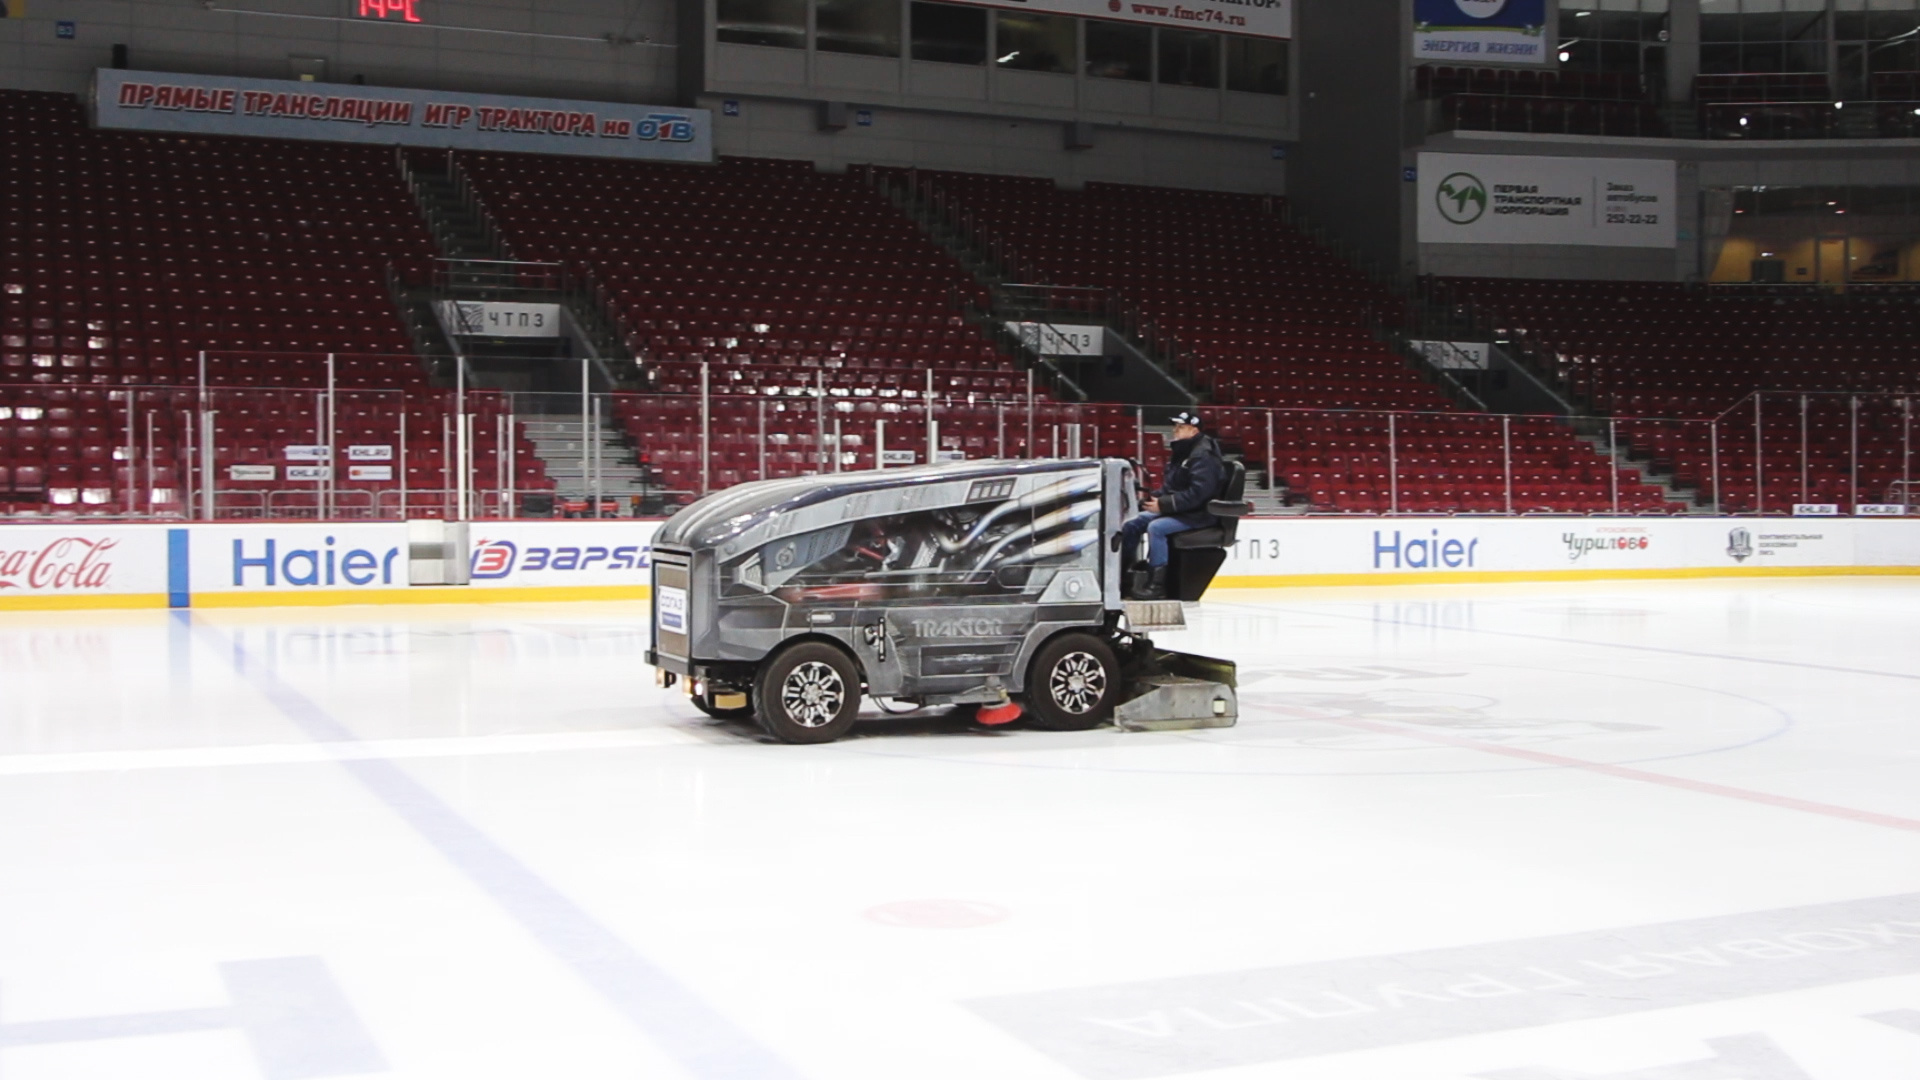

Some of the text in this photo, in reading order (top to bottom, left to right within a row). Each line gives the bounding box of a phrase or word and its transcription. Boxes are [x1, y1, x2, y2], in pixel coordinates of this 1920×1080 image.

[1131, 4, 1246, 26] www.fmc74.ru
[1421, 40, 1539, 55] ЭНЕРГИЯ ЖИЗНИ!
[118, 82, 235, 113] ПРЯМЫЕ
[243, 91, 412, 126] ТРАНСЛЯЦИИ
[422, 103, 472, 128] ИГР
[479, 107, 597, 136] ТРАКТОРА
[601, 119, 631, 138] на
[1493, 184, 1538, 194] ПЕРВАЯ
[1493, 195, 1582, 206] ТРАНСПОРТНАЯ
[1493, 206, 1569, 216] КОРПОРАЦИЯ
[1606, 214, 1658, 224] 252-22-22
[488, 312, 544, 328] ЧТПЗ
[1233, 539, 1281, 560] ТПЗ
[1373, 528, 1479, 568] Haier
[1562, 532, 1649, 561] Чурилово
[232, 535, 399, 586] Haier
[911, 617, 1003, 637] TRAKTOR
[1085, 964, 1584, 1036] ГРУППА
